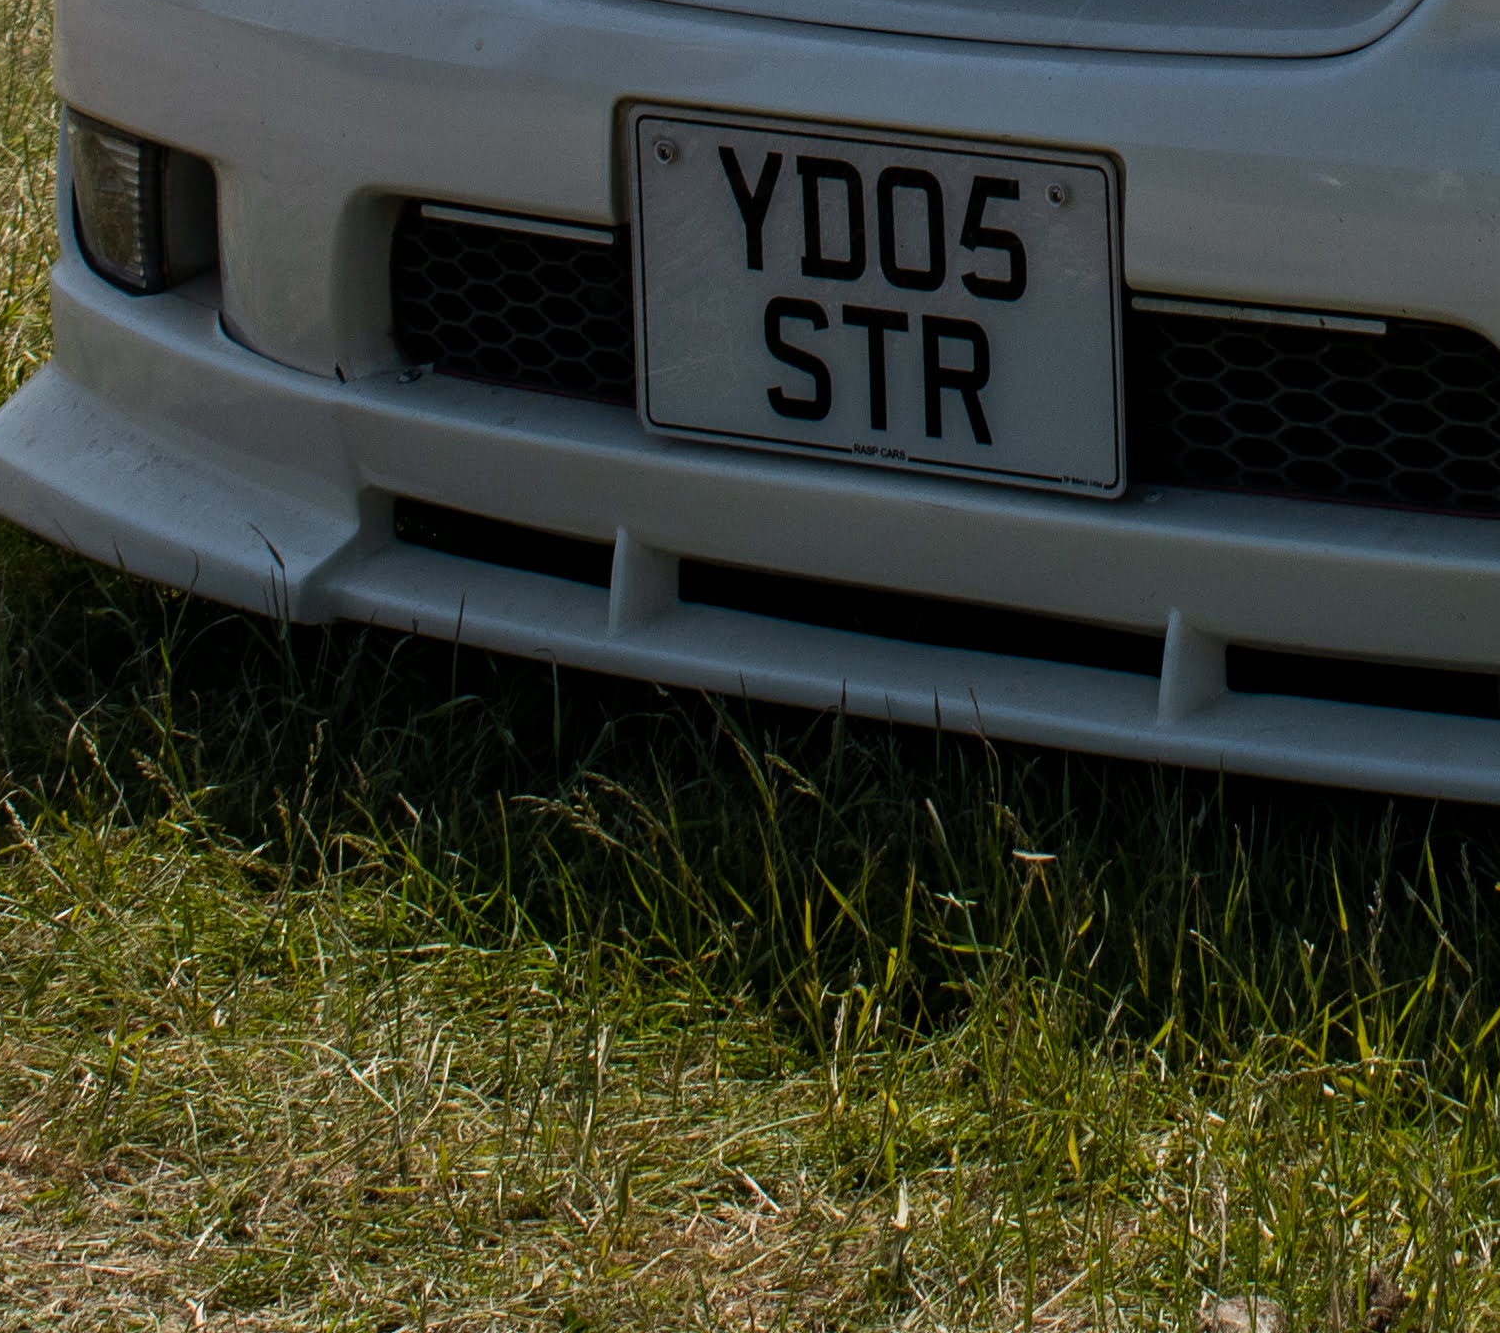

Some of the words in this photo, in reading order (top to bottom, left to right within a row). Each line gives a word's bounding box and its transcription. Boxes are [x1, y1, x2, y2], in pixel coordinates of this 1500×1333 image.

[718, 145, 1028, 302] YD05
[763, 295, 993, 446] STR
[880, 446, 906, 461] CARS
